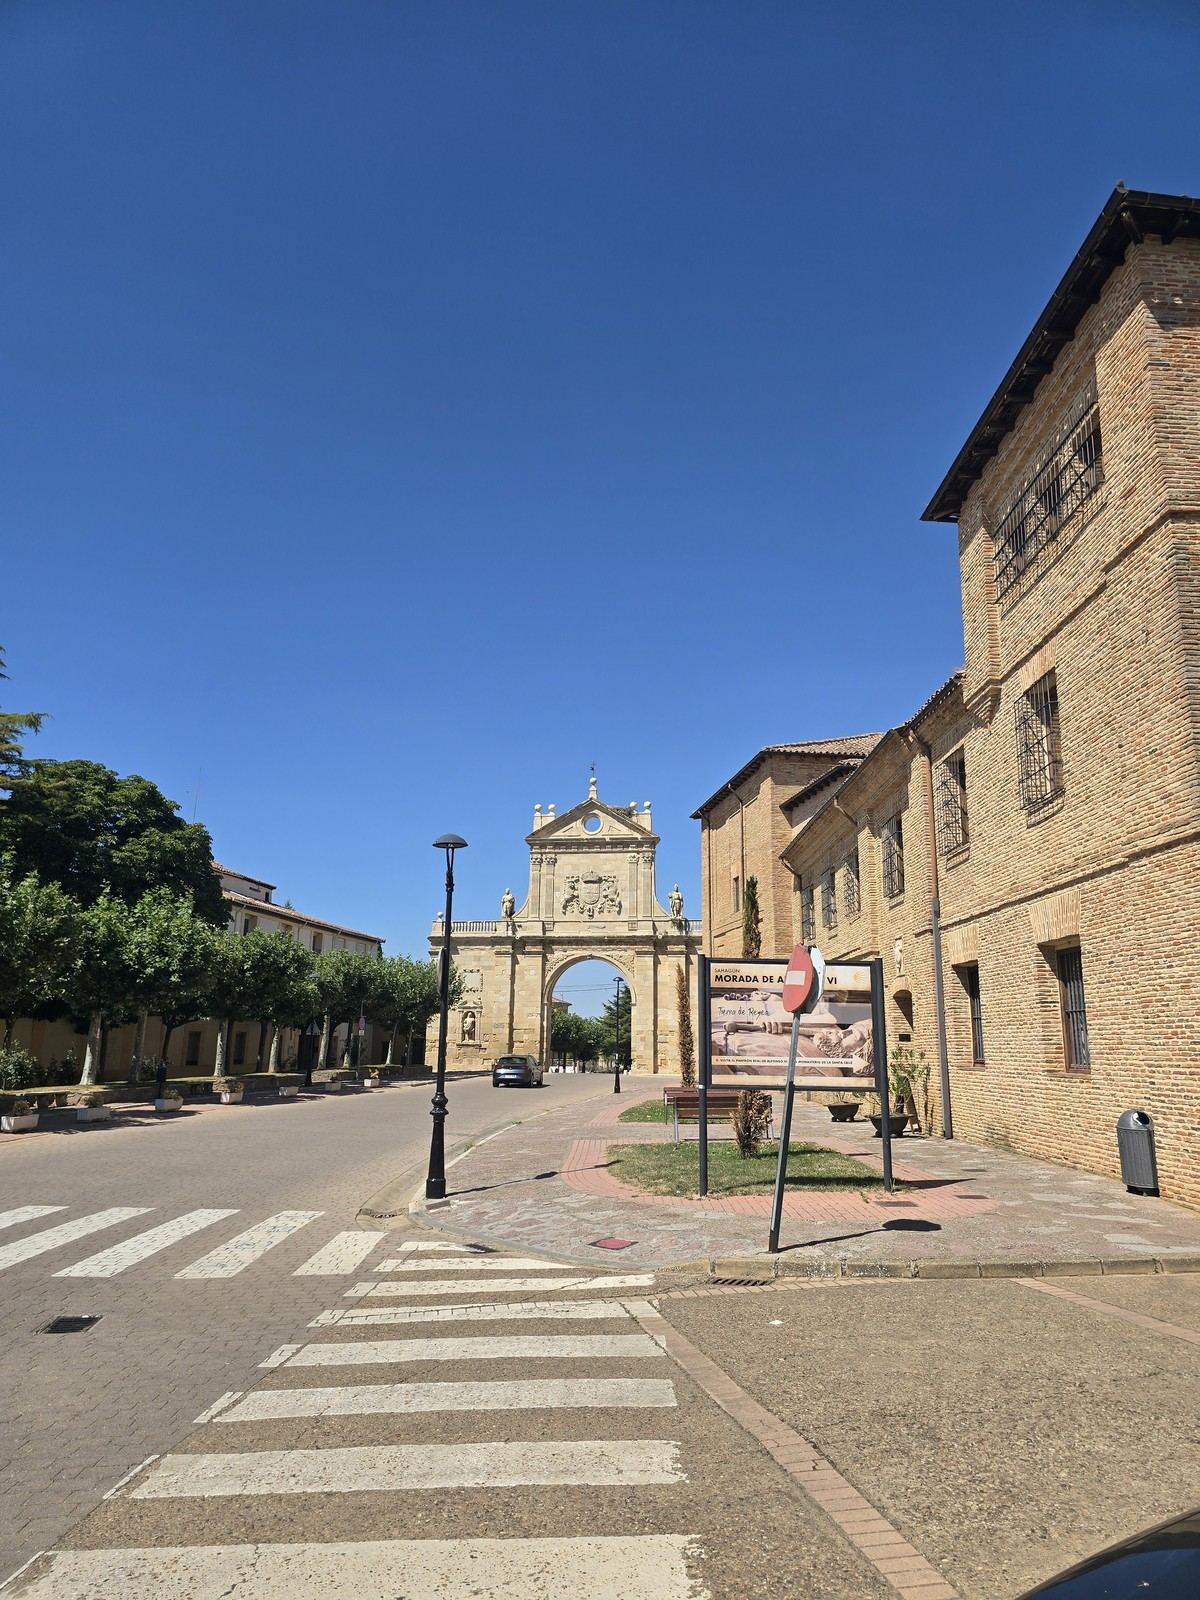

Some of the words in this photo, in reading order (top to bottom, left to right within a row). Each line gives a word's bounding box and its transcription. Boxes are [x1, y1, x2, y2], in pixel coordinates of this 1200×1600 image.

[714, 975, 759, 983] MORADA
[762, 975, 774, 983] DE
[827, 976, 837, 985] VI
[738, 1006, 746, 1016] de
